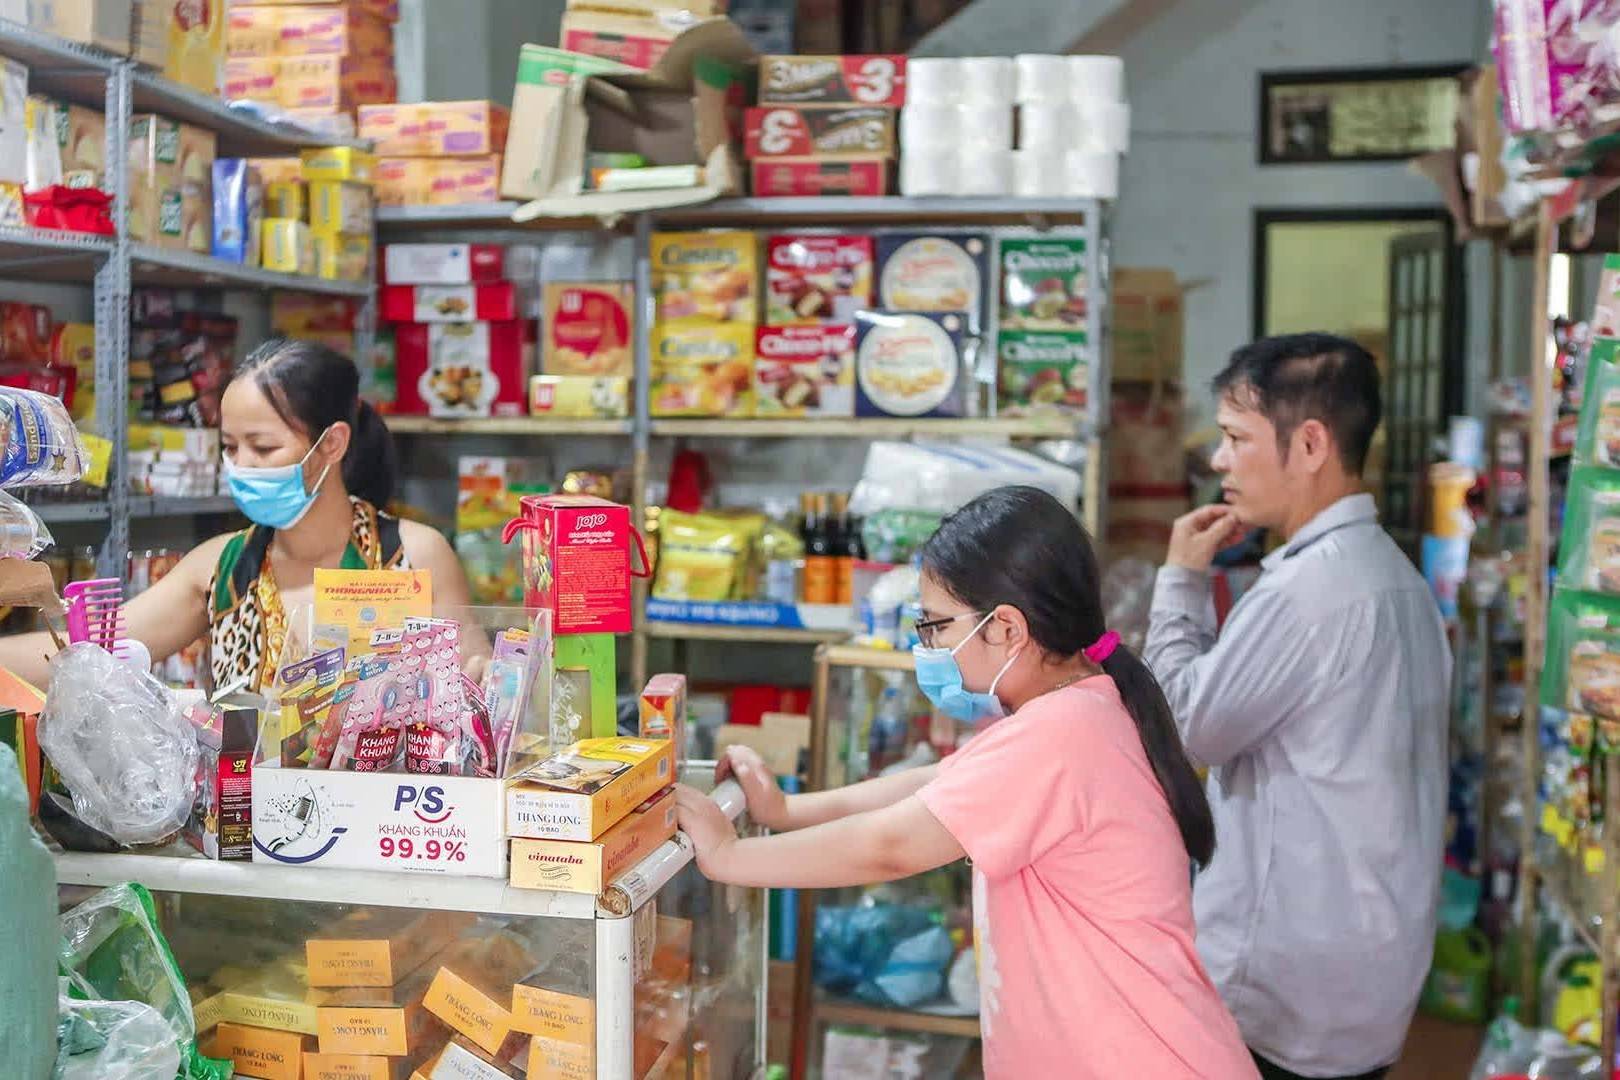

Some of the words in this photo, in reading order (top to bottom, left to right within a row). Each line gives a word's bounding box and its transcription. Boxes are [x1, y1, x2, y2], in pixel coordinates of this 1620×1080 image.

[394, 785, 445, 814] P/S
[552, 815, 581, 825] LONG
[528, 851, 584, 865] vinataba
